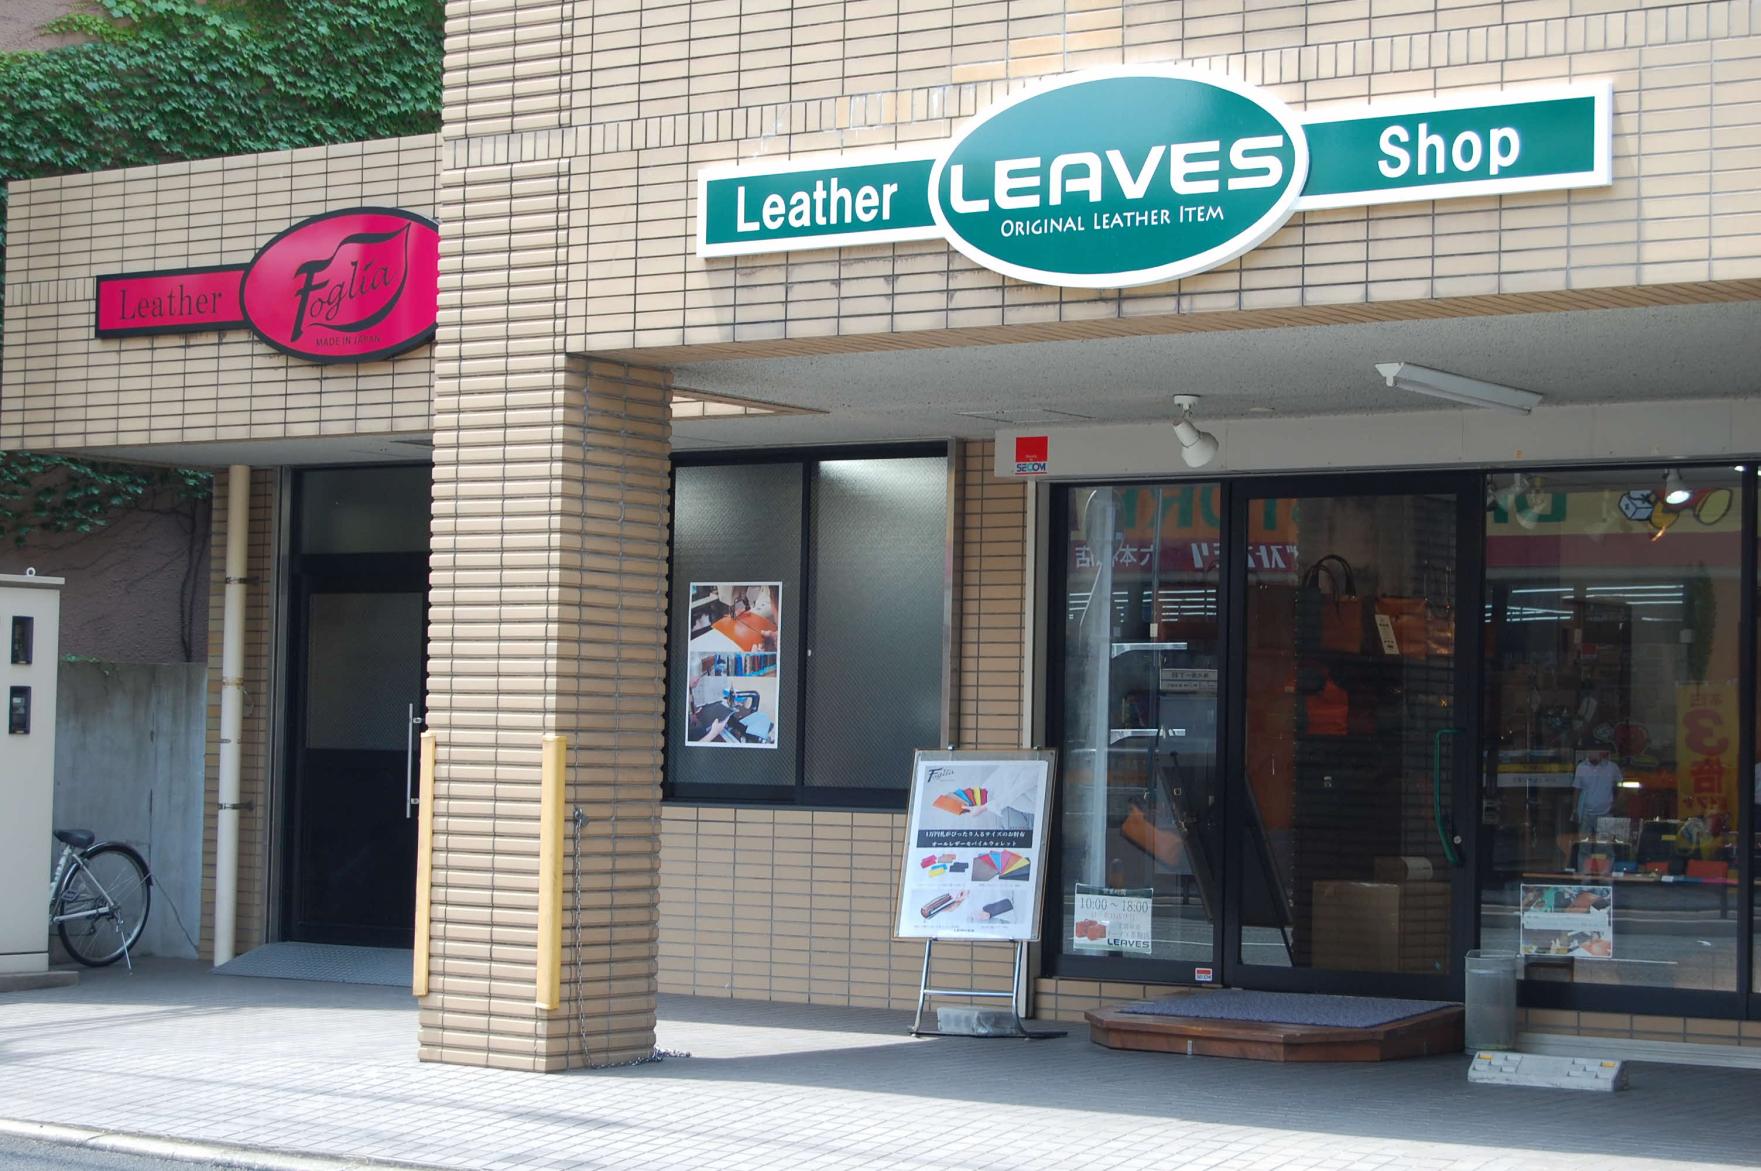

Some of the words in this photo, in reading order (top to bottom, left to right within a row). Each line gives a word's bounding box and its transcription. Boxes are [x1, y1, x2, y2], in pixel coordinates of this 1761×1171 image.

[1377, 122, 1521, 178] Shop
[949, 134, 1286, 214] LEAVES
[736, 177, 899, 233] Leather
[1000, 215, 1086, 238] ORIGINAL
[1093, 208, 1171, 232] LEATHER
[1179, 204, 1225, 224] ITEM
[120, 284, 223, 321] Leather
[315, 336, 340, 347] MADE
[342, 336, 351, 345] IN
[354, 334, 381, 345] JAPAN
[1016, 463, 1046, 472] SECOM
[1107, 938, 1150, 949] LEAVES
